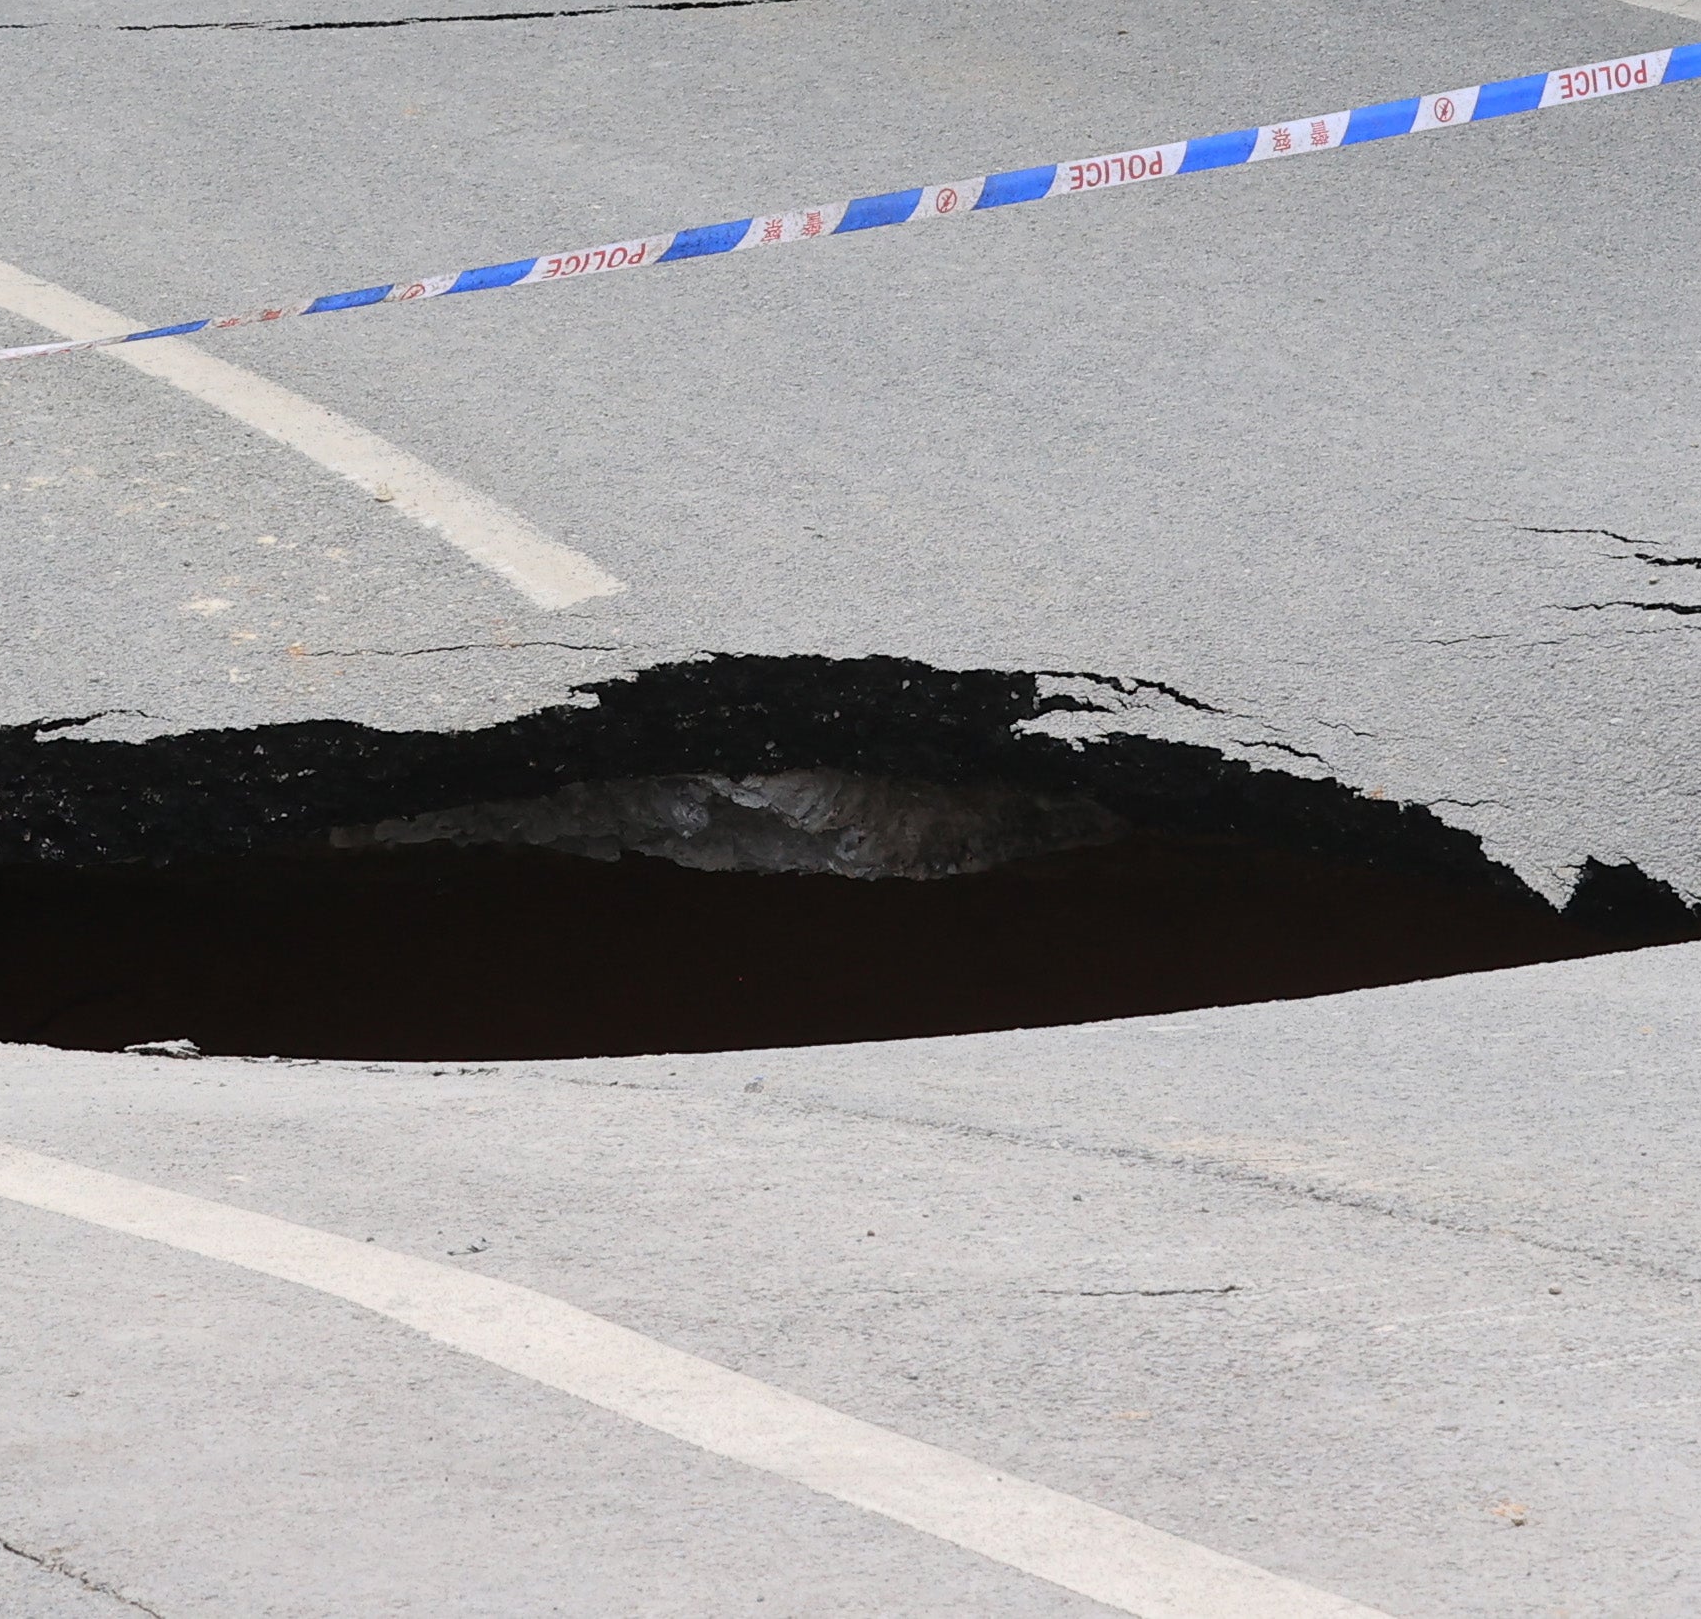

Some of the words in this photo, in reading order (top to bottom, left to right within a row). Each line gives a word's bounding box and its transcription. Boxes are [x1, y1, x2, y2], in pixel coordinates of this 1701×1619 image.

[1559, 59, 1648, 99] POLICE
[1271, 119, 1330, 153] 警察
[1069, 150, 1163, 191] POLICE
[542, 242, 647, 279] POLICE
